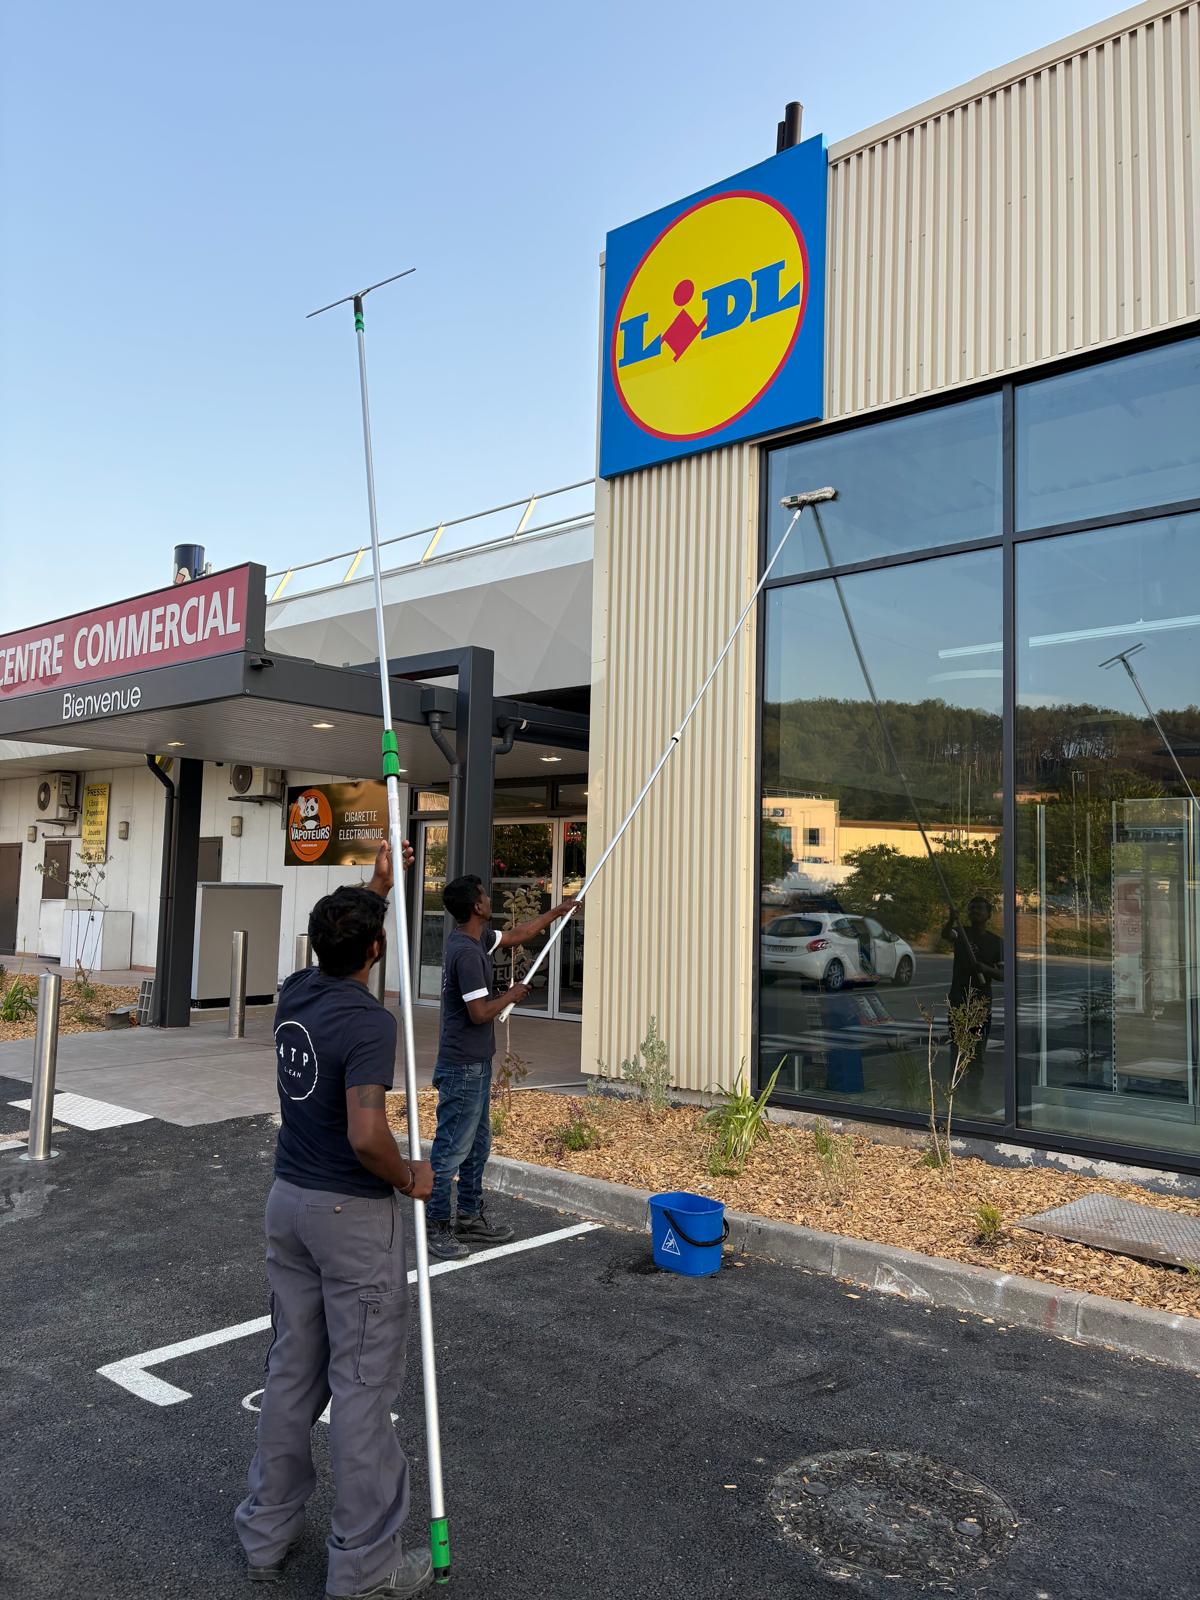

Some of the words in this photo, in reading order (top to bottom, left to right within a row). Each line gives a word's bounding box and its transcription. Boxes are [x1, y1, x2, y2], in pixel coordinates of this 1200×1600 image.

[73, 587, 241, 670] COMMERCIAL
[62, 686, 142, 720] Bienvenue
[344, 811, 377, 822] CIGARETTE
[291, 826, 330, 840] VAPOTEURS
[339, 828, 383, 840] ELECTRONIQUE
